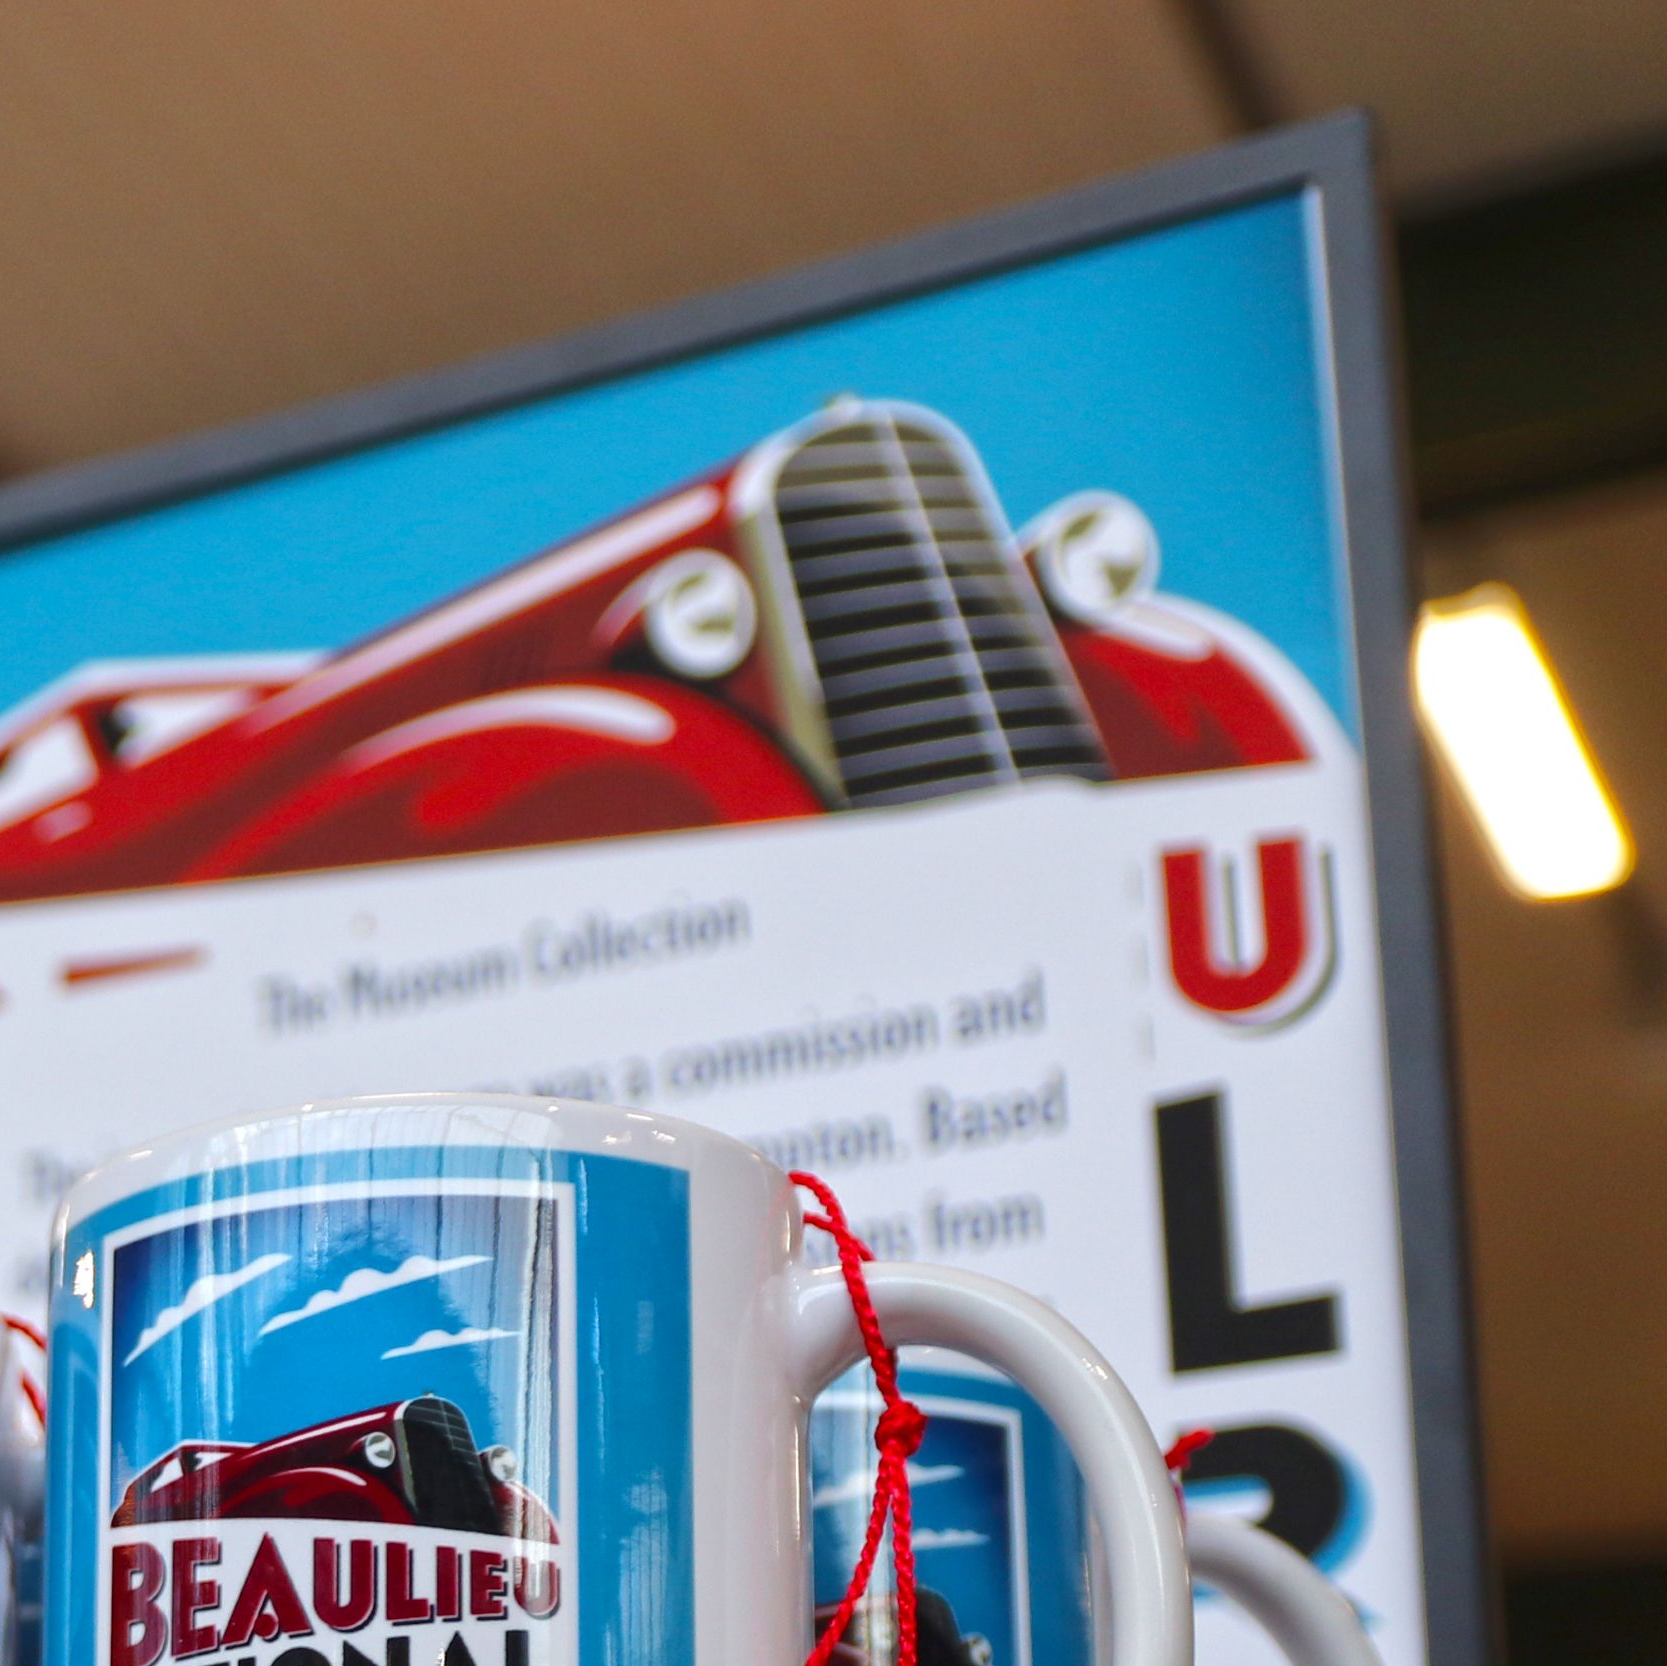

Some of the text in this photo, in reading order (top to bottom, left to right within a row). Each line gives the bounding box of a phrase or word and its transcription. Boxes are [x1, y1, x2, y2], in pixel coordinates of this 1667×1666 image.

[341, 944, 519, 1012] Museum
[525, 897, 752, 983] Collection
[665, 1002, 939, 1092] commission
[951, 965, 1045, 1047] and
[921, 1064, 1068, 1153] Based
[929, 1190, 1047, 1253] from
